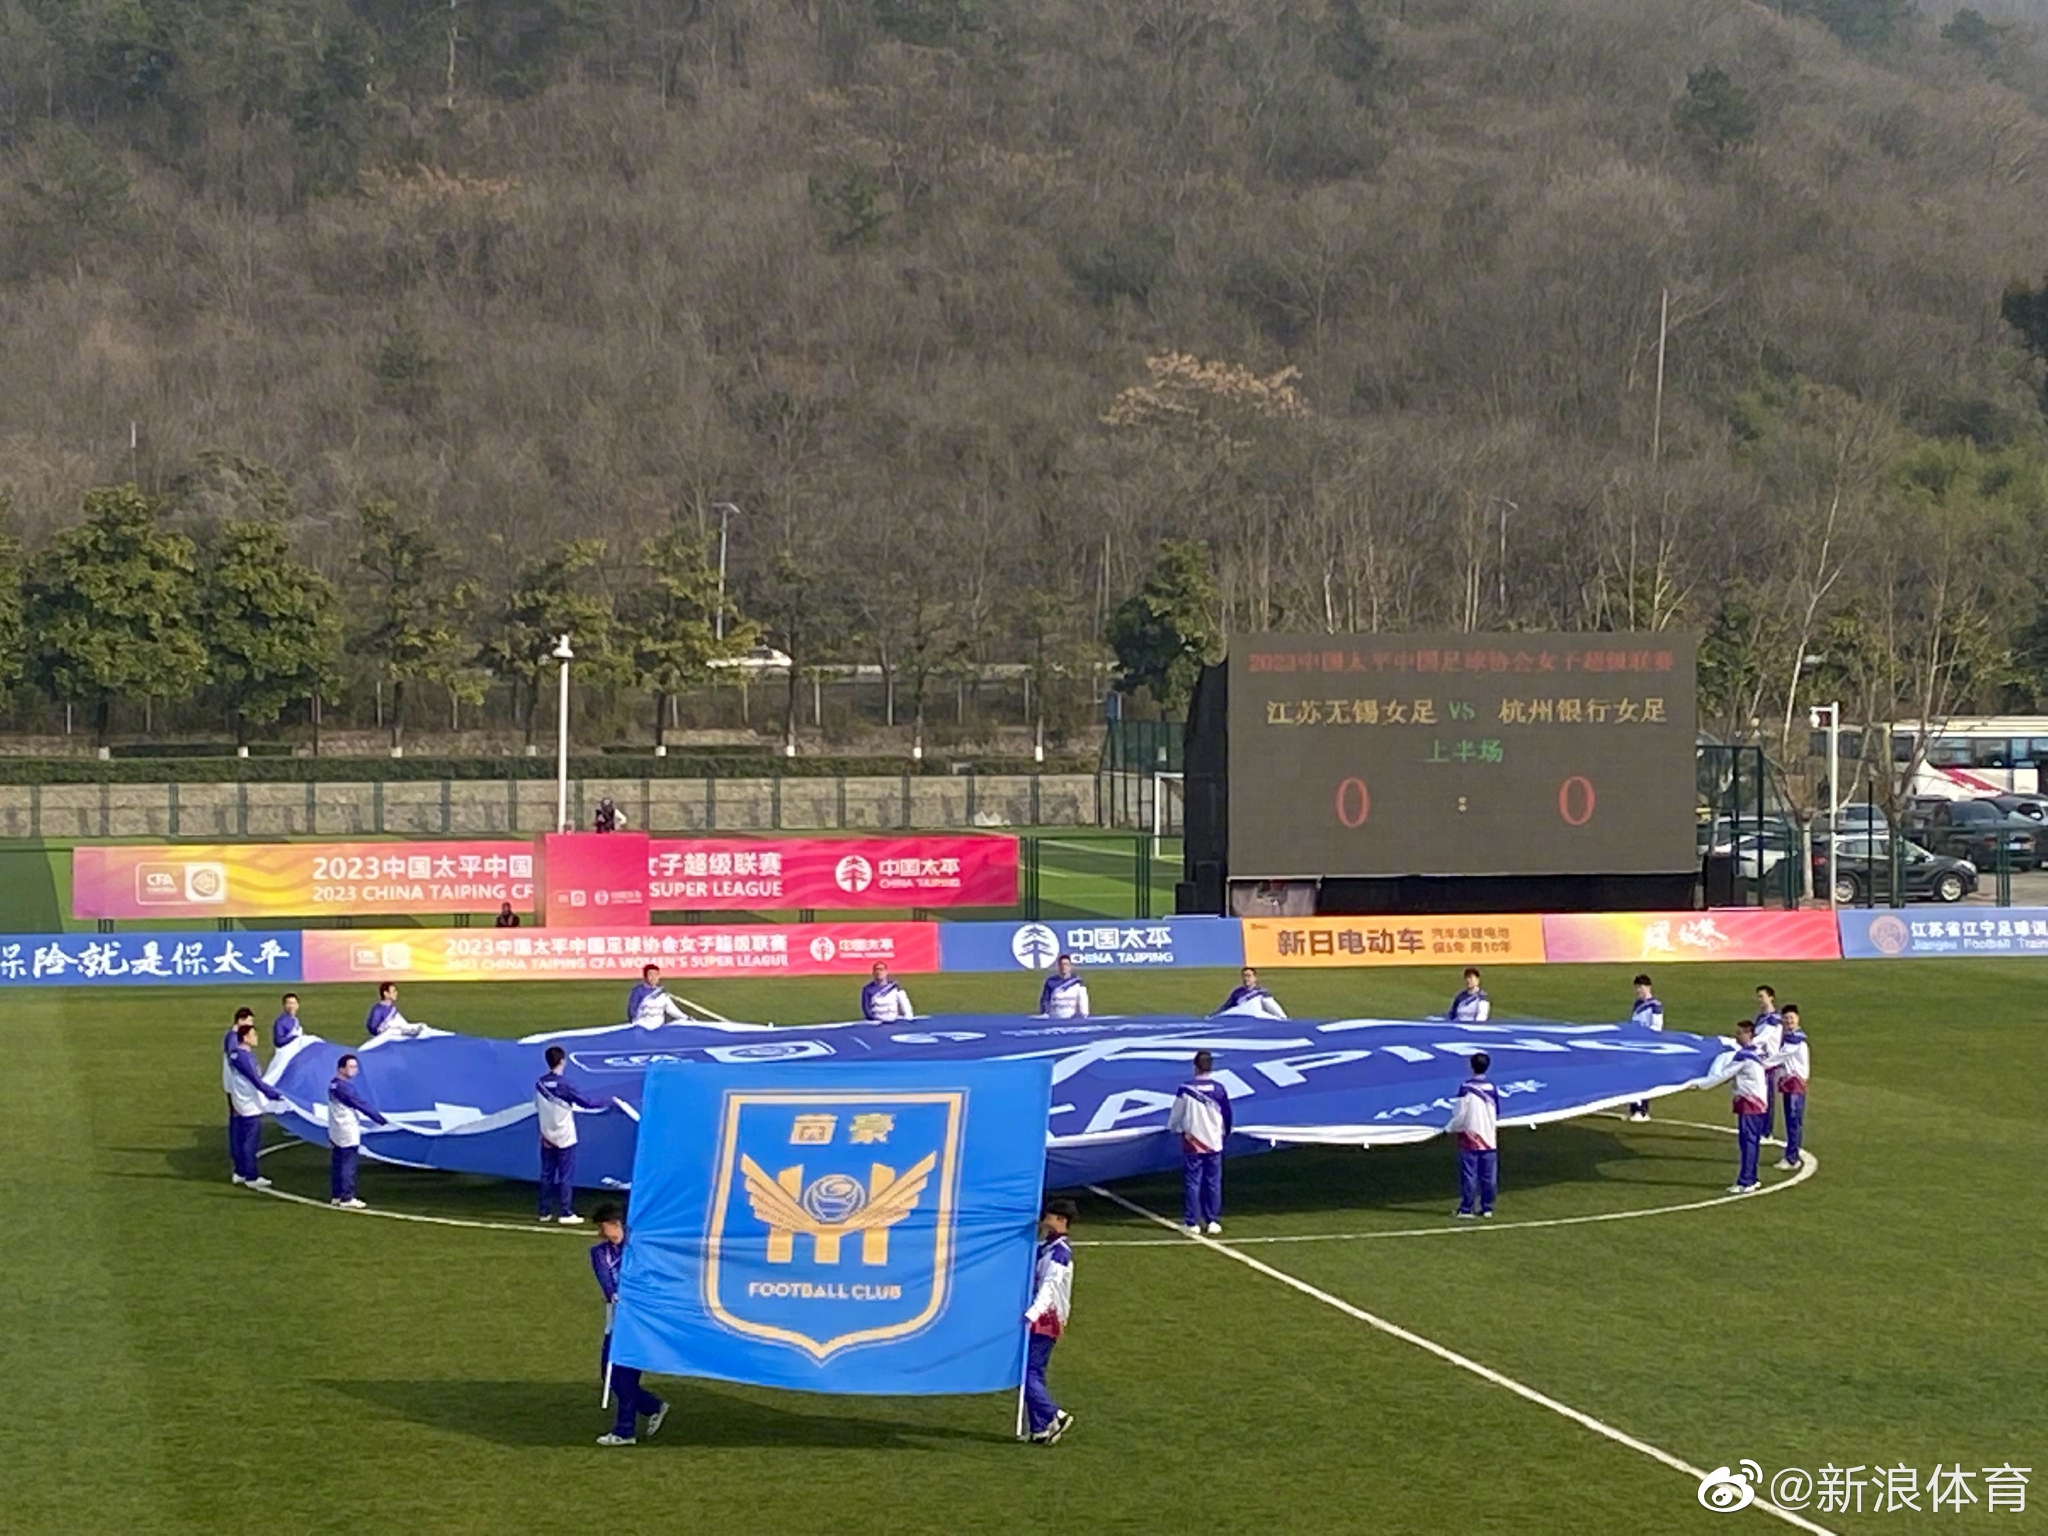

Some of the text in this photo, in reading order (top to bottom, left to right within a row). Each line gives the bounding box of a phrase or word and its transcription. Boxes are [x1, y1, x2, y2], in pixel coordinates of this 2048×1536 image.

[1266, 699, 1438, 726] 江苏无锡女足
[1498, 698, 1668, 724] 杭州银行女足
[1424, 739, 1504, 763] 上半场
[1335, 776, 1371, 828] 0
[1558, 774, 1596, 826] 0
[878, 858, 961, 876] 中国太平
[313, 883, 534, 902] 2023 CHINA TAIPING CF
[649, 880, 783, 897] SUPER LEAGUE
[1067, 926, 1172, 951] 中国太平
[1277, 928, 1425, 956] 新日电动车
[589, 957, 616, 969] CFA
[690, 955, 735, 968] SUPER
[737, 953, 788, 967] LEAGUE
[1070, 952, 1174, 964] CHINA TAIPING
[749, 1281, 902, 1300] FOOTBALL CLUB
